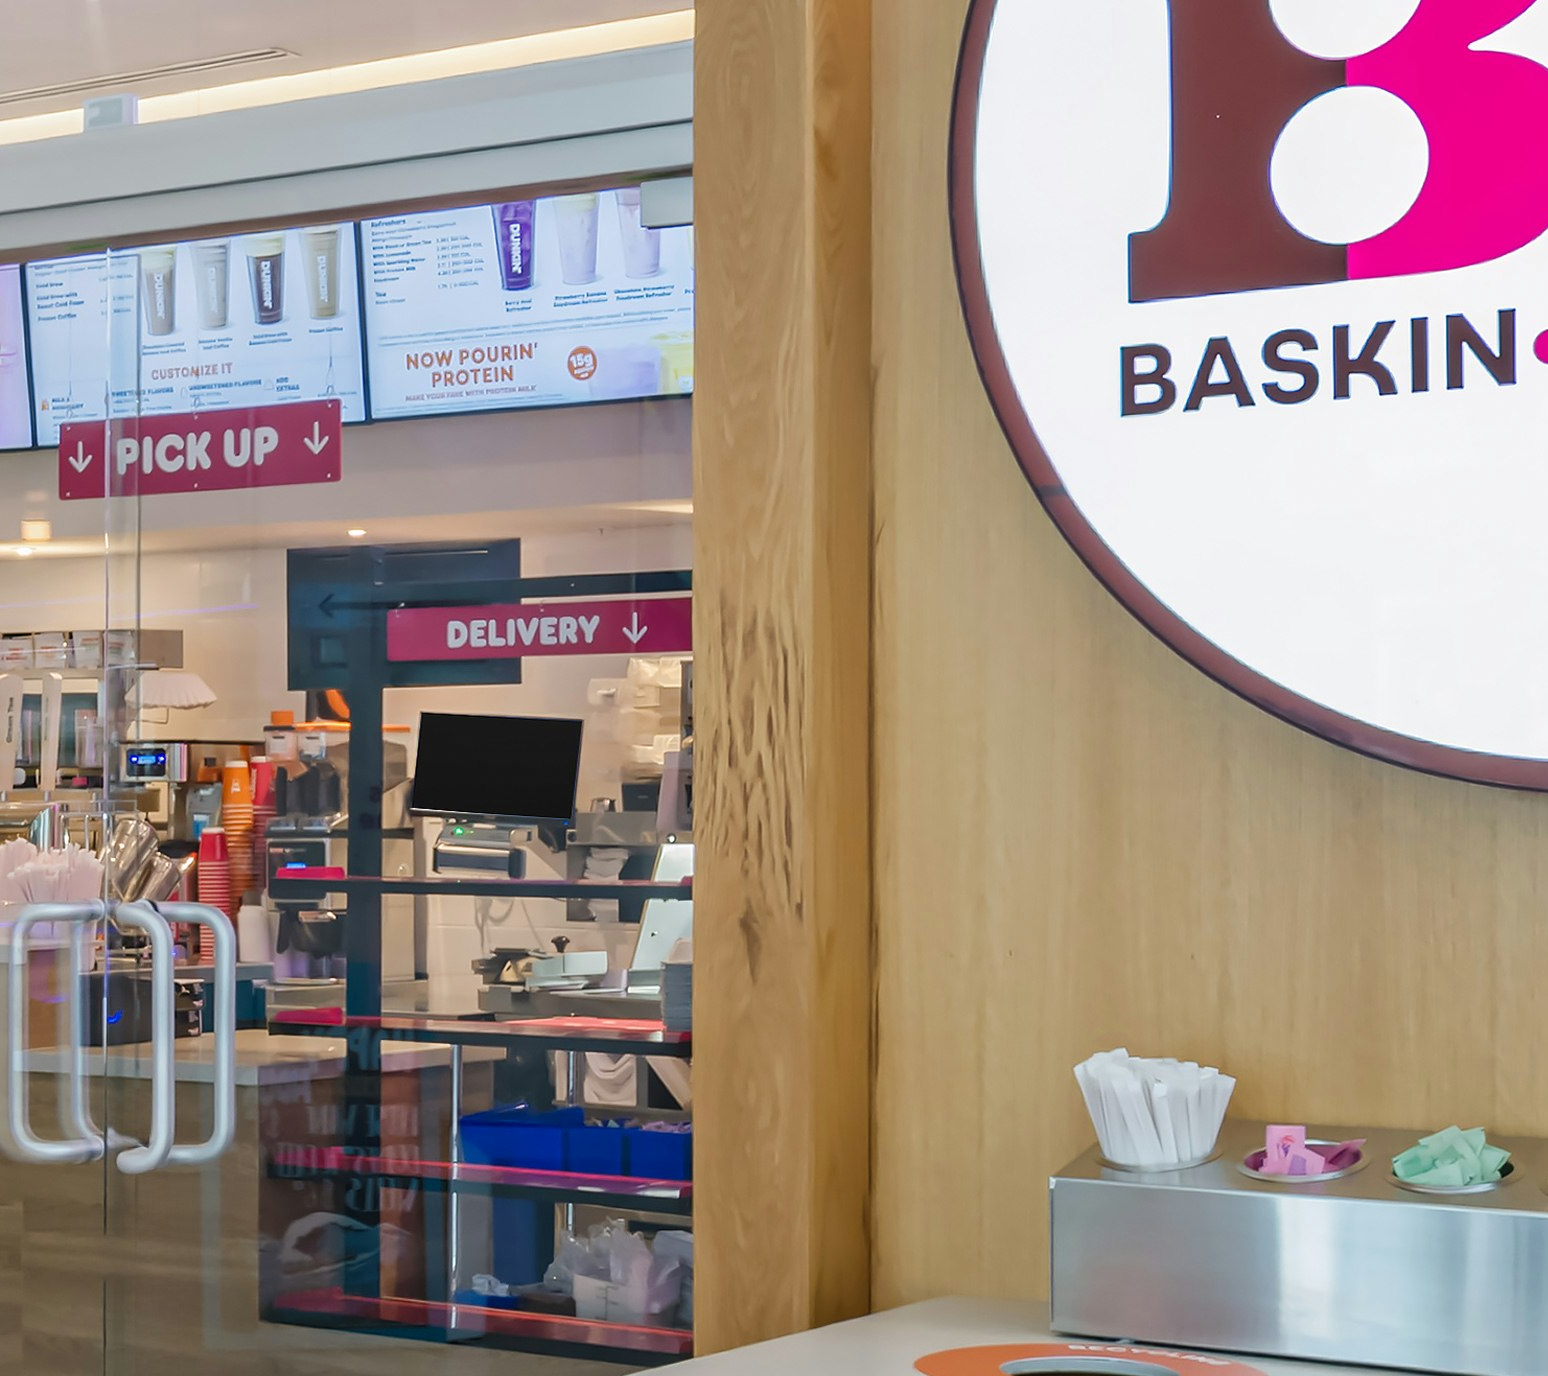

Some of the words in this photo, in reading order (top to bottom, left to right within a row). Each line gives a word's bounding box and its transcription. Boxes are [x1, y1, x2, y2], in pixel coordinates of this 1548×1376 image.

[406, 349, 453, 371] NOW
[459, 342, 539, 366] POURIN'
[431, 365, 514, 388] PROTEIN
[116, 430, 212, 475] PICK
[222, 425, 279, 467] UP
[446, 615, 601, 649] DELIVERY
